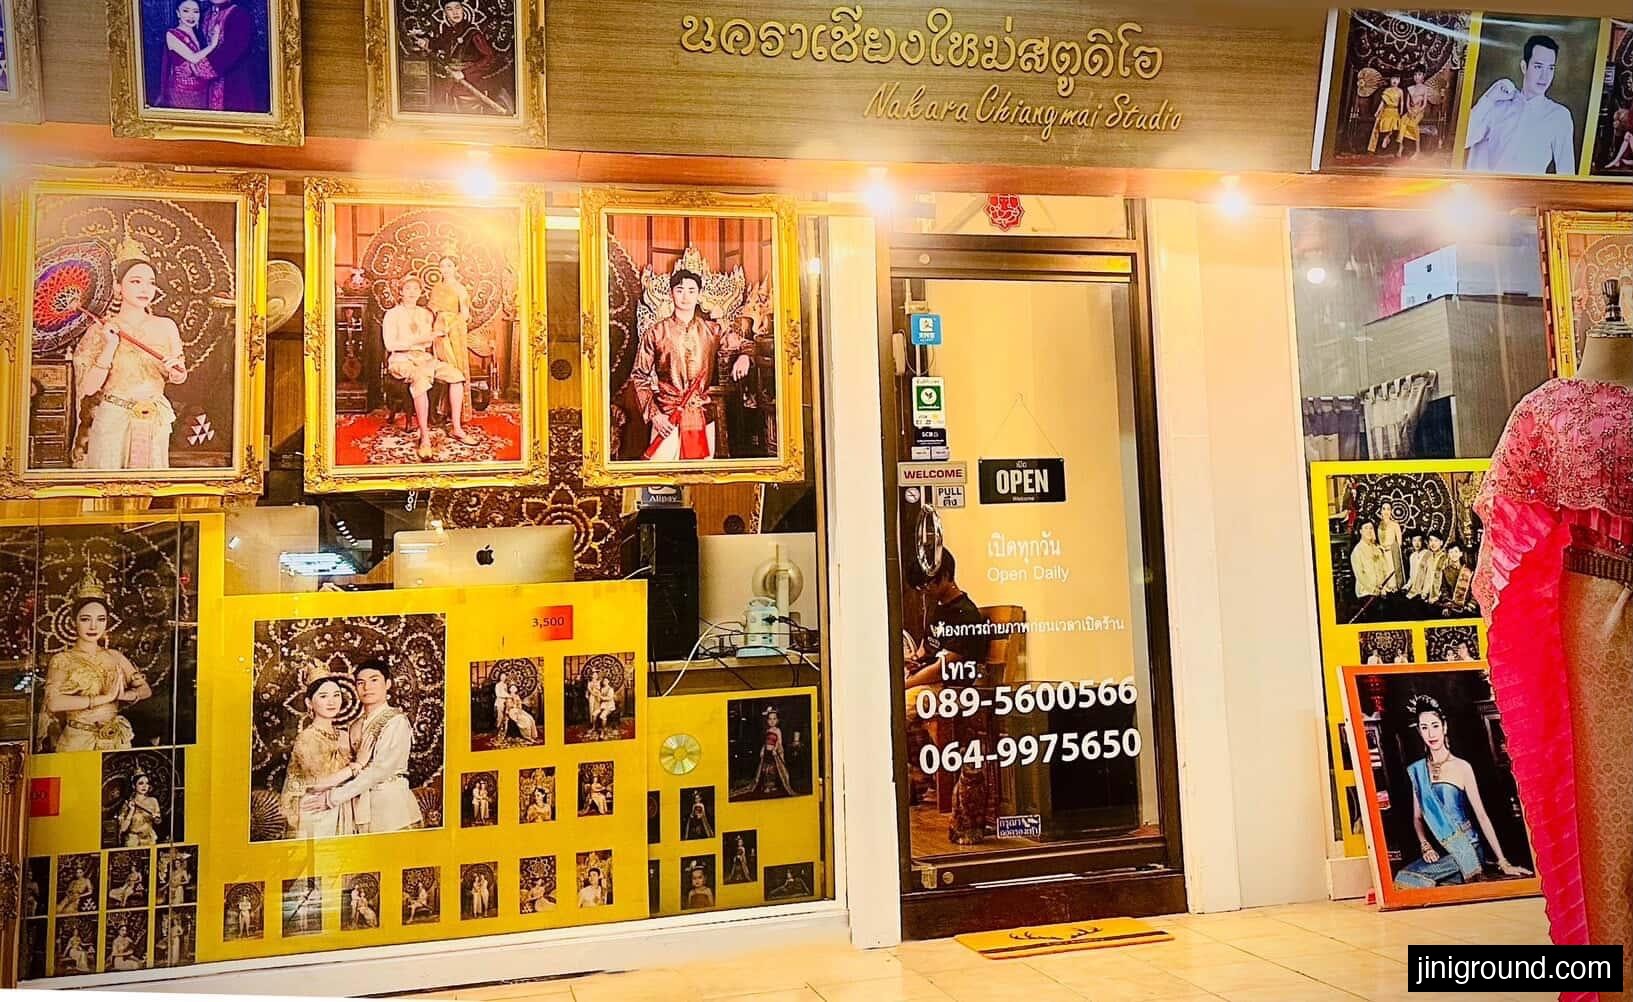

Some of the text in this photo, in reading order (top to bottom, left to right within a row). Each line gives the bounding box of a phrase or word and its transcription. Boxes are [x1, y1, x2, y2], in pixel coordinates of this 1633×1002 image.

[680, 5, 1164, 98] นคราเชียงใหม่สตูดิโอ
[863, 81, 1184, 140] Nakara Chiangmai Studio
[904, 468, 964, 480] WELCOME
[996, 469, 1049, 494] OPEN
[938, 487, 963, 496] PULL
[987, 530, 1062, 565] เปิดทุกวัน
[987, 564, 1070, 584] Open Daily
[531, 616, 566, 629] 3,500
[936, 649, 983, 681] โทร.
[915, 676, 1138, 720] 089-5600566
[919, 728, 1142, 775] 064-9975650
